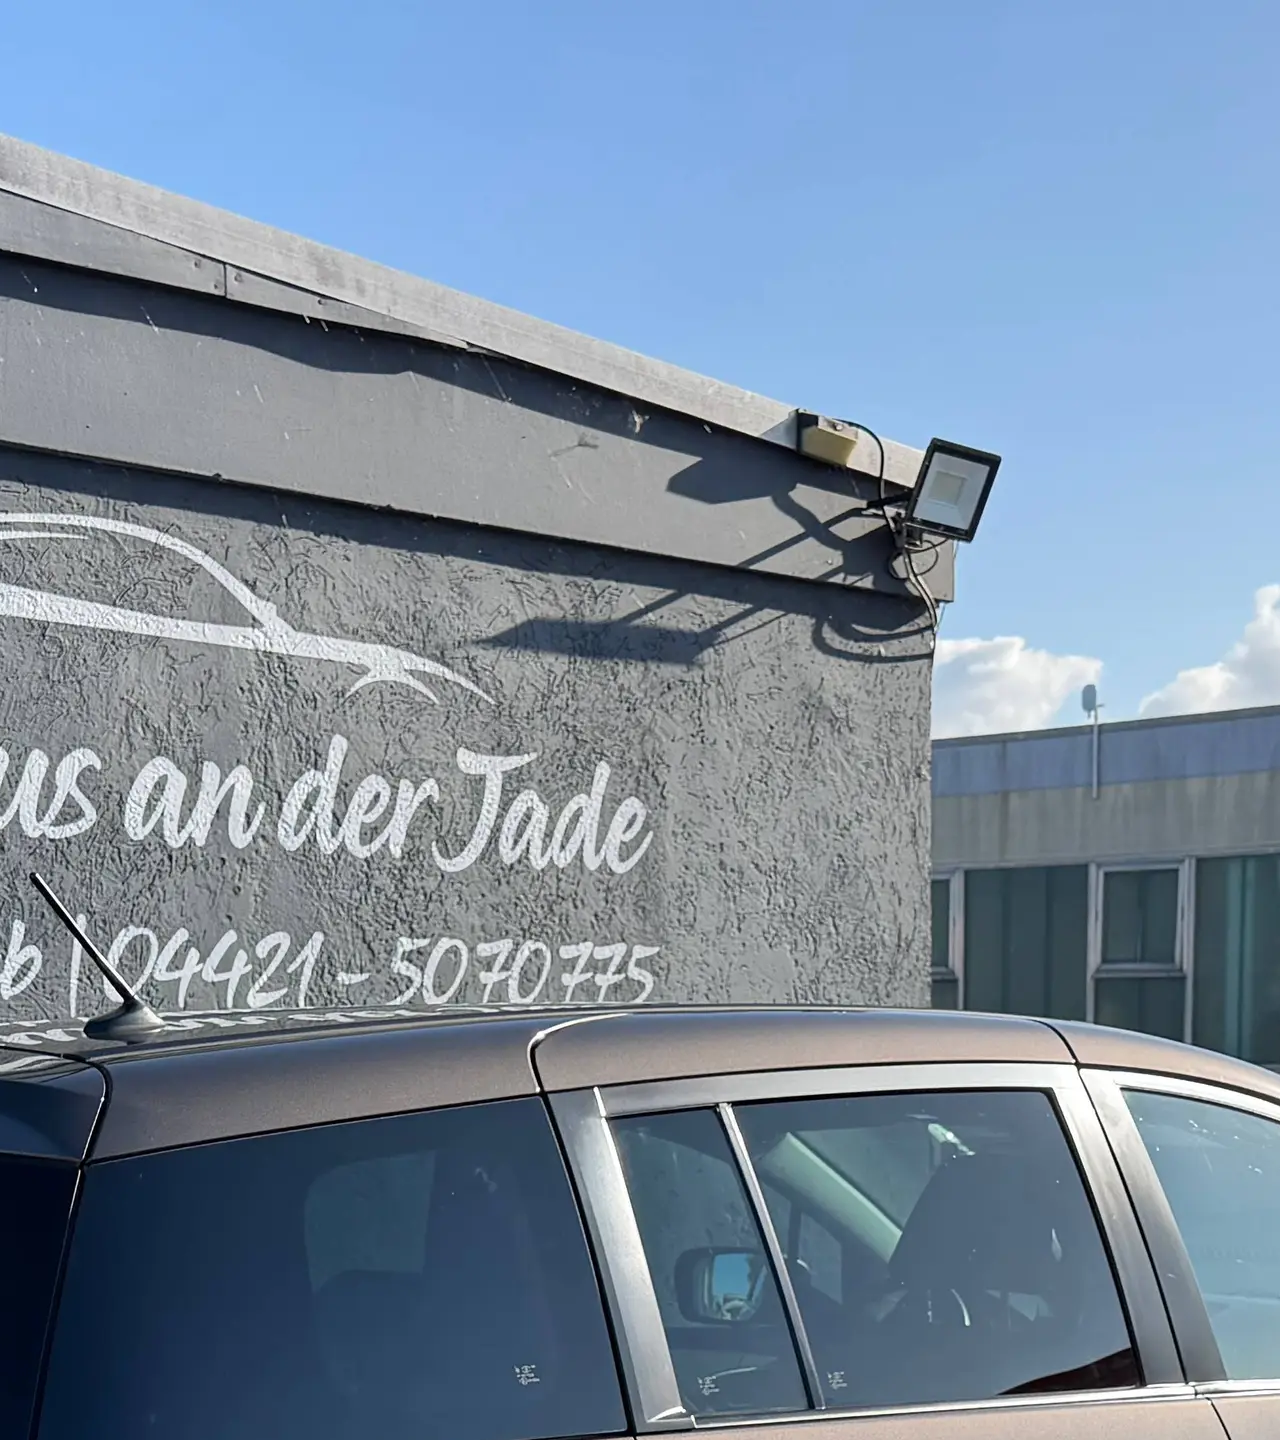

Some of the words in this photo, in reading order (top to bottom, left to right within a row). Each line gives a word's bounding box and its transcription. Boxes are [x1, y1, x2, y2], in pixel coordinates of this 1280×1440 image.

[123, 755, 265, 850] an
[277, 733, 439, 860] der
[431, 746, 654, 874] Jade
[103, 923, 325, 1010] 04421
[386, 935, 662, 1006] 5070775
